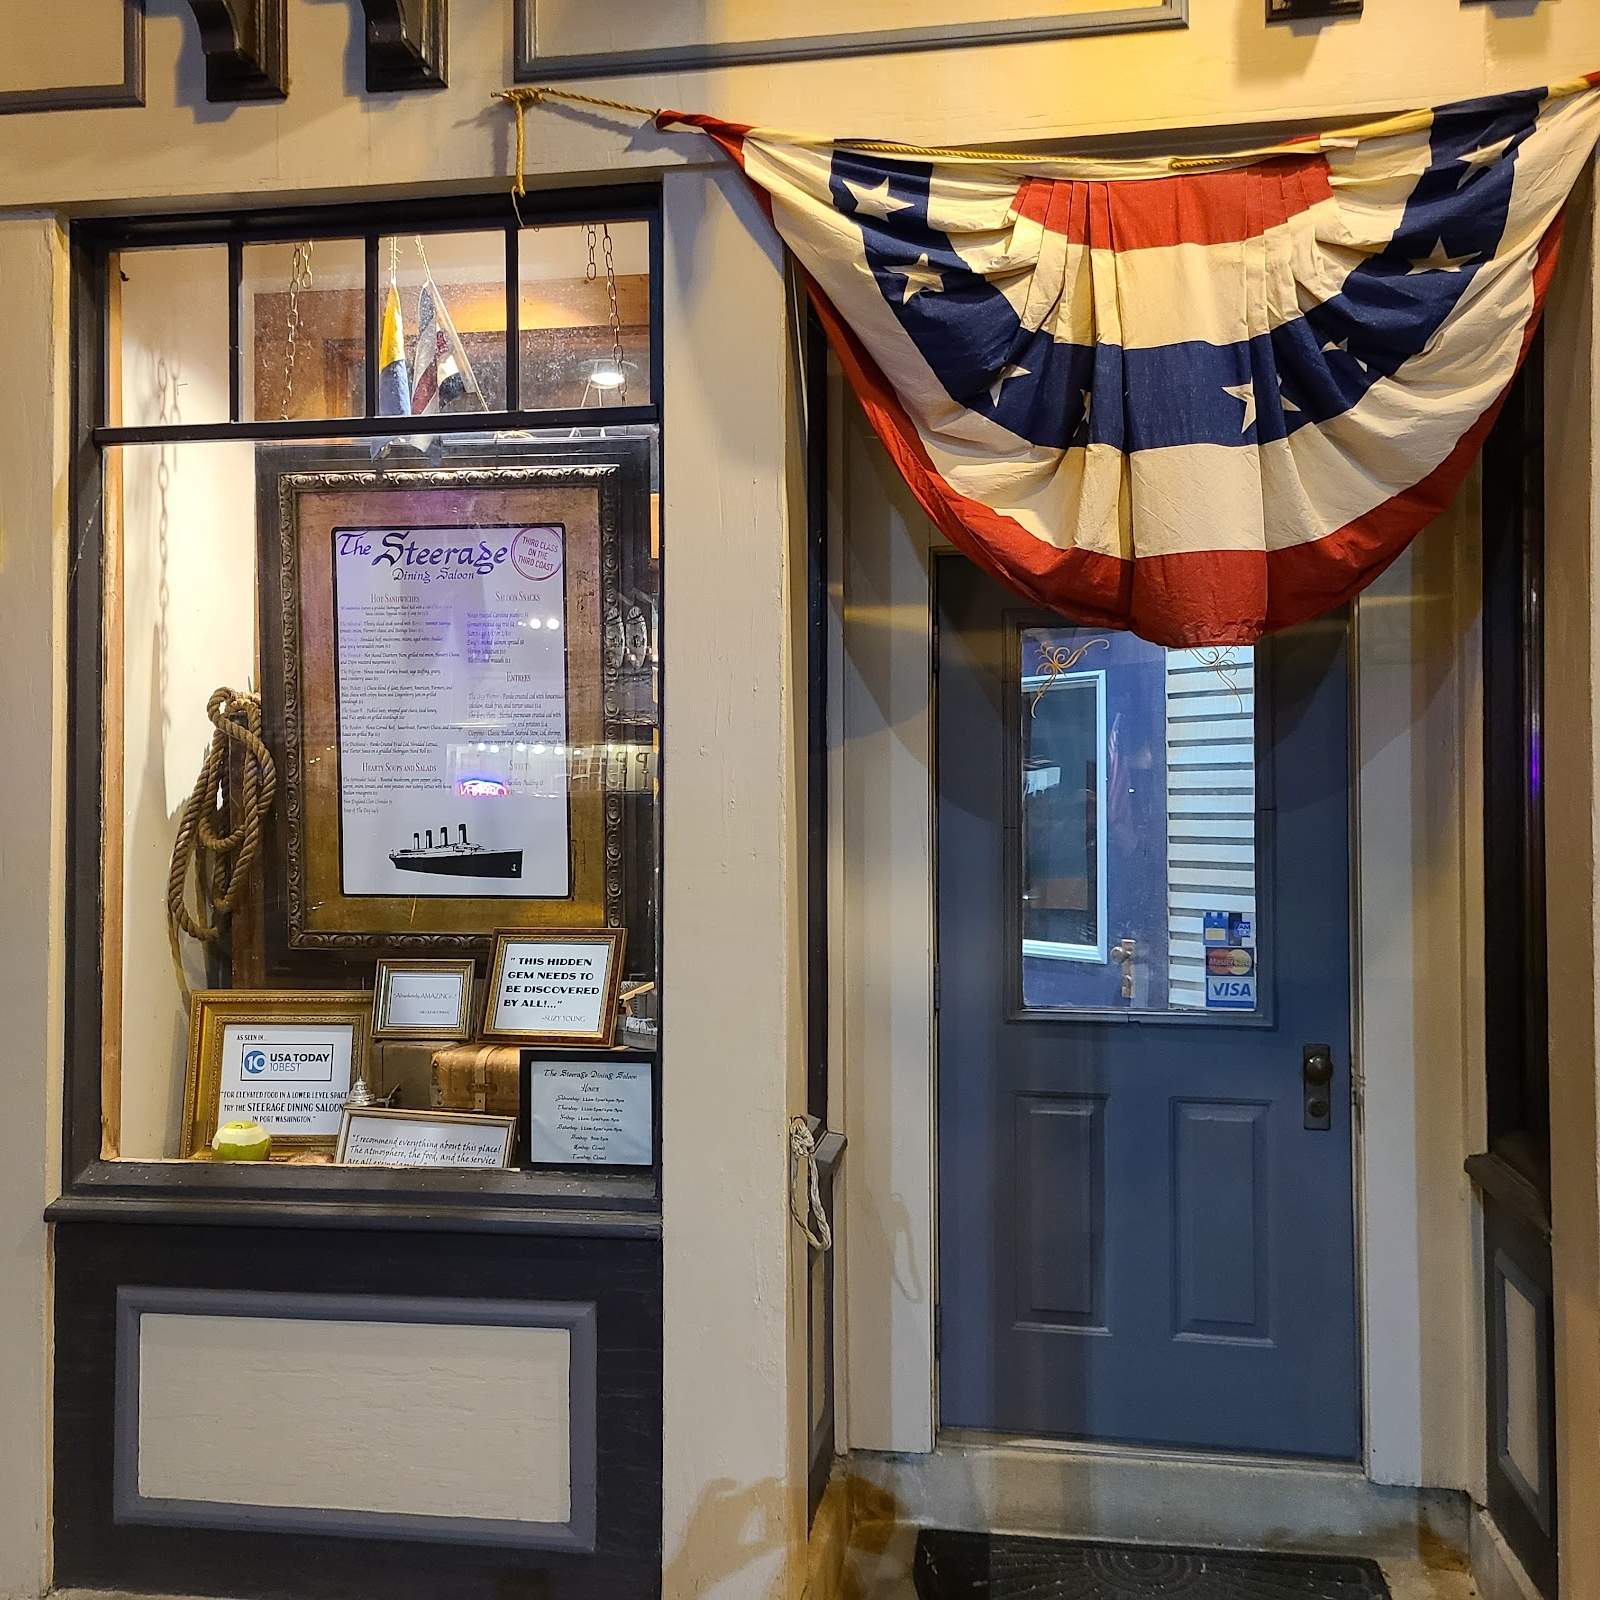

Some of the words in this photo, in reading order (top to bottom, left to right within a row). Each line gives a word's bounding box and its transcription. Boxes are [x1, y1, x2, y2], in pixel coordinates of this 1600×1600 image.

[522, 536, 539, 548] THIRD
[540, 541, 559, 552] CLASS
[337, 531, 372, 556] The
[372, 531, 508, 575] Steerage
[528, 548, 537, 557] ON
[538, 550, 549, 560] THE
[518, 555, 535, 566] THIRD
[535, 560, 554, 571] COAST
[392, 567, 431, 583] Dining
[436, 567, 475, 580] Saloon
[362, 762, 385, 772] HEARTY
[385, 762, 403, 772] SOUPS
[415, 762, 437, 772] SALADS
[519, 957, 544, 965] THIS
[547, 958, 593, 966] HIDDEN
[507, 971, 535, 979] GEM
[537, 972, 577, 980] NEEDS
[580, 972, 594, 980] TO
[506, 985, 521, 993] BE
[523, 985, 600, 995] DISCOVERED
[1213, 983, 1252, 996] VISA
[503, 999, 519, 1007] BY
[270, 1053, 291, 1062] USA
[293, 1053, 330, 1062] TODAY
[270, 1062, 302, 1072] 10BEST
[544, 1069, 557, 1077] The
[559, 1069, 588, 1080] Steerage
[590, 1070, 614, 1080] Dining
[615, 1071, 638, 1080] Saloon
[235, 1091, 263, 1099] ELEVATED
[264, 1091, 279, 1099] FOOD
[280, 1091, 286, 1099] IN
[286, 1091, 291, 1099] A
[292, 1091, 311, 1099] LOWER
[312, 1091, 329, 1099] LEVEL
[224, 1104, 235, 1112] TRY
[235, 1104, 246, 1112] THE
[247, 1102, 286, 1112] STEERAGE
[287, 1102, 314, 1112] DINING
[315, 1103, 344, 1113] SALOON
[252, 1115, 258, 1123] IN
[259, 1115, 274, 1123] PORT
[360, 1136, 399, 1146] recommend
[399, 1138, 438, 1150] everything
[440, 1139, 461, 1150] about
[462, 1140, 477, 1151] this
[350, 1144, 363, 1154] The
[364, 1146, 407, 1159] atmosphere,
[409, 1148, 421, 1159] the
[421, 1149, 438, 1162] food,
[440, 1153, 455, 1164] and
[456, 1152, 469, 1163] the
[470, 1155, 496, 1165] service
